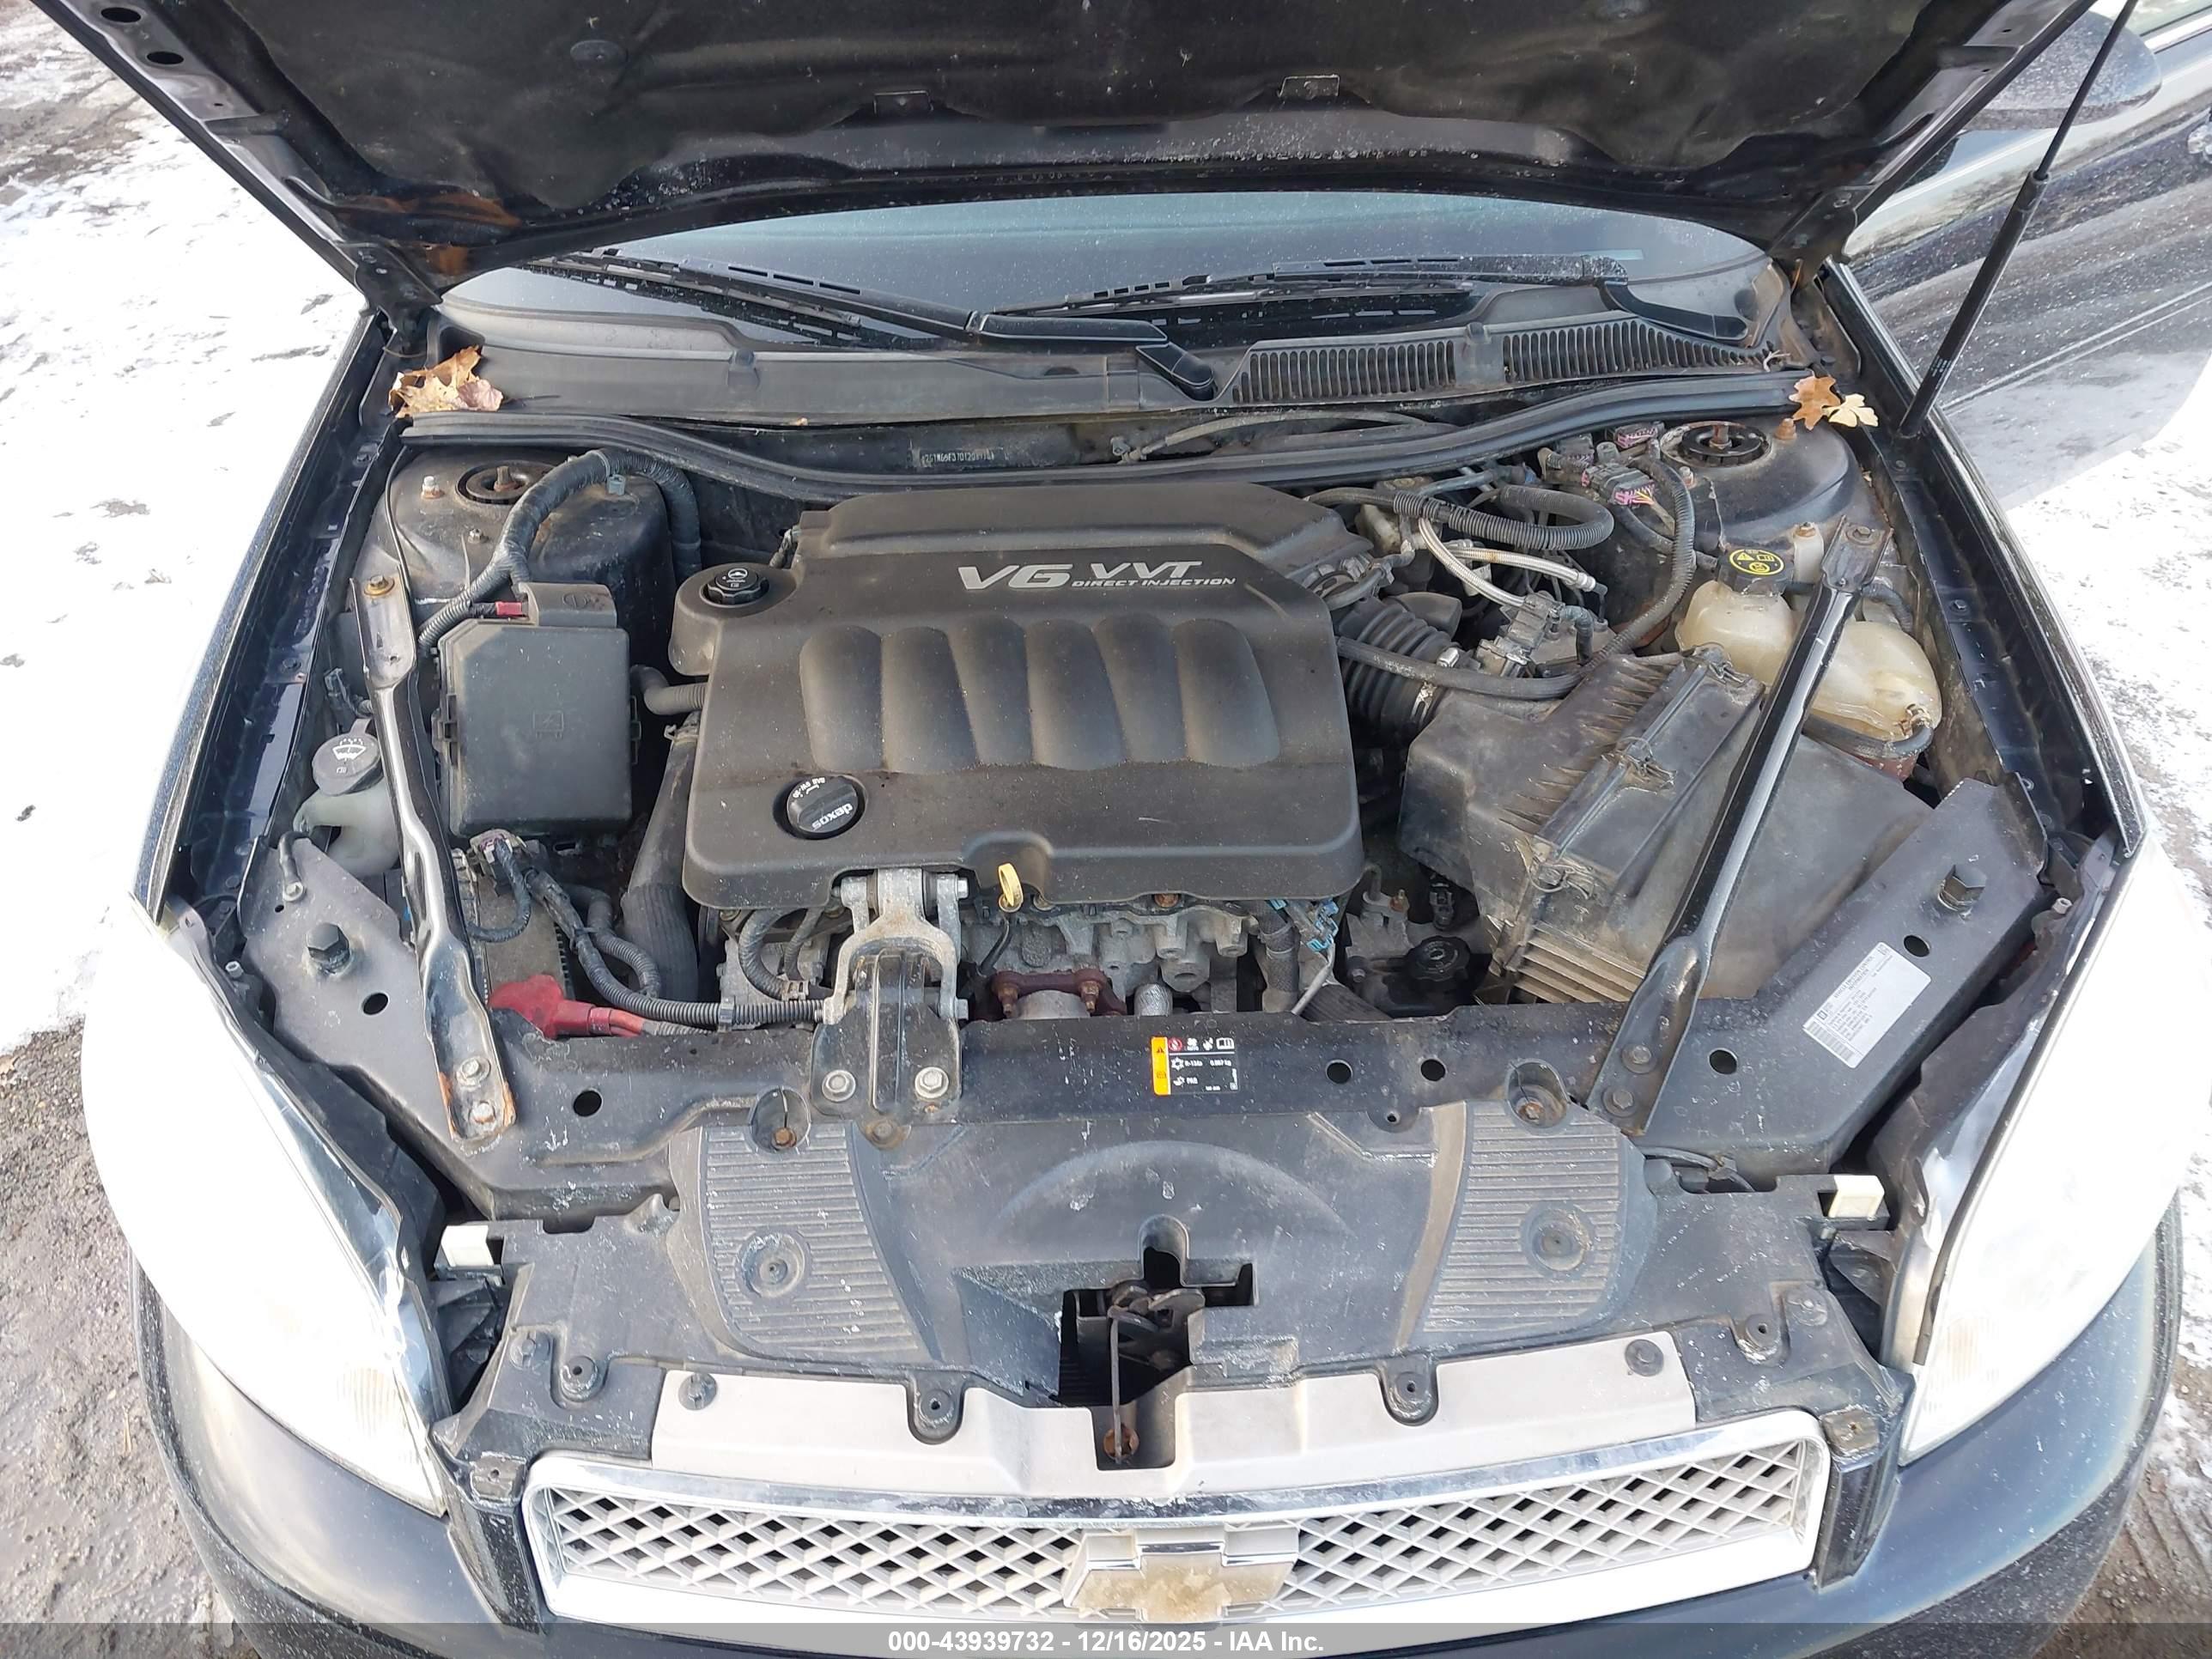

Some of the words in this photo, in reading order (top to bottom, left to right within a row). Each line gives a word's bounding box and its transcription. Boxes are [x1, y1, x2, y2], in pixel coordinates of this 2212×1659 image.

[958, 563, 1073, 590] V6
[1090, 561, 1202, 579] VVT
[1072, 578, 1137, 587] DIRECT
[1141, 577, 1237, 586] INJECTION
[811, 803, 853, 830] dexos
